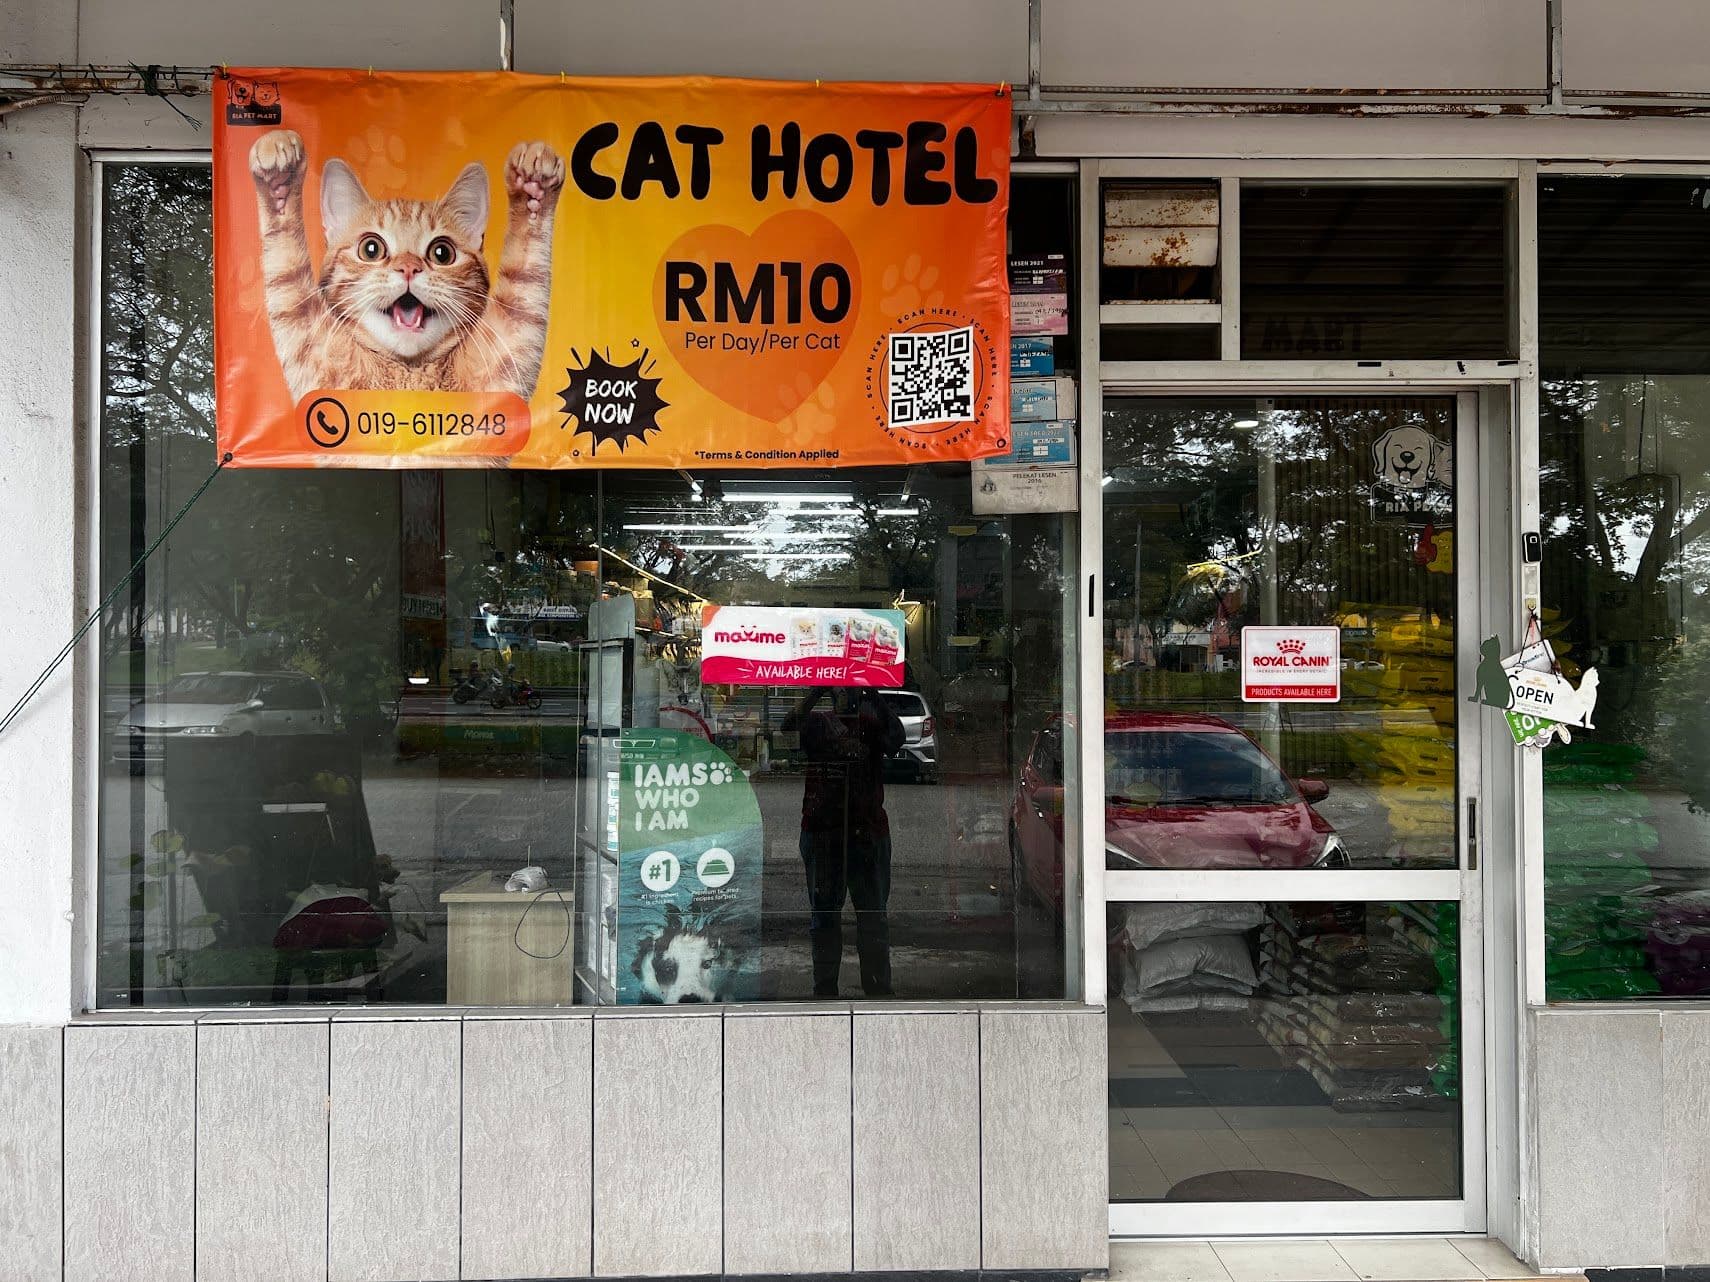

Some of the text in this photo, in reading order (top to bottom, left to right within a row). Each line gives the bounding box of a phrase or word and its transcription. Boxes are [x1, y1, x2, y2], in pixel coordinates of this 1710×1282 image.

[570, 120, 998, 206] CAT HOTEL
[664, 260, 852, 326] RM10
[897, 308, 958, 325] SCAN HERE
[685, 328, 841, 356] Per Day/Per Cat
[970, 318, 998, 377] SCAN HERE
[865, 334, 886, 399] SCAN HERE
[584, 378, 639, 400] BOOK
[357, 412, 507, 436] 019-6112848
[584, 402, 636, 425] NOW
[946, 396, 993, 446] SCAN HERE
[875, 415, 927, 450] SCAN HERE
[734, 450, 743, 460] &
[744, 449, 797, 460] Condition
[798, 448, 840, 462] Applied
[1385, 501, 1410, 513] RIA
[714, 626, 786, 645] maxime
[756, 664, 847, 680] AVAILABLE HERE!
[1253, 656, 1329, 667] ROYAL CANIN
[1251, 687, 1332, 697] PRODUCTS AVAILABLE HERE
[1516, 685, 1554, 705] OPEN
[634, 762, 709, 788] IAMS
[634, 787, 700, 810] WHO
[634, 809, 689, 832] I AM
[648, 858, 671, 882] #1
